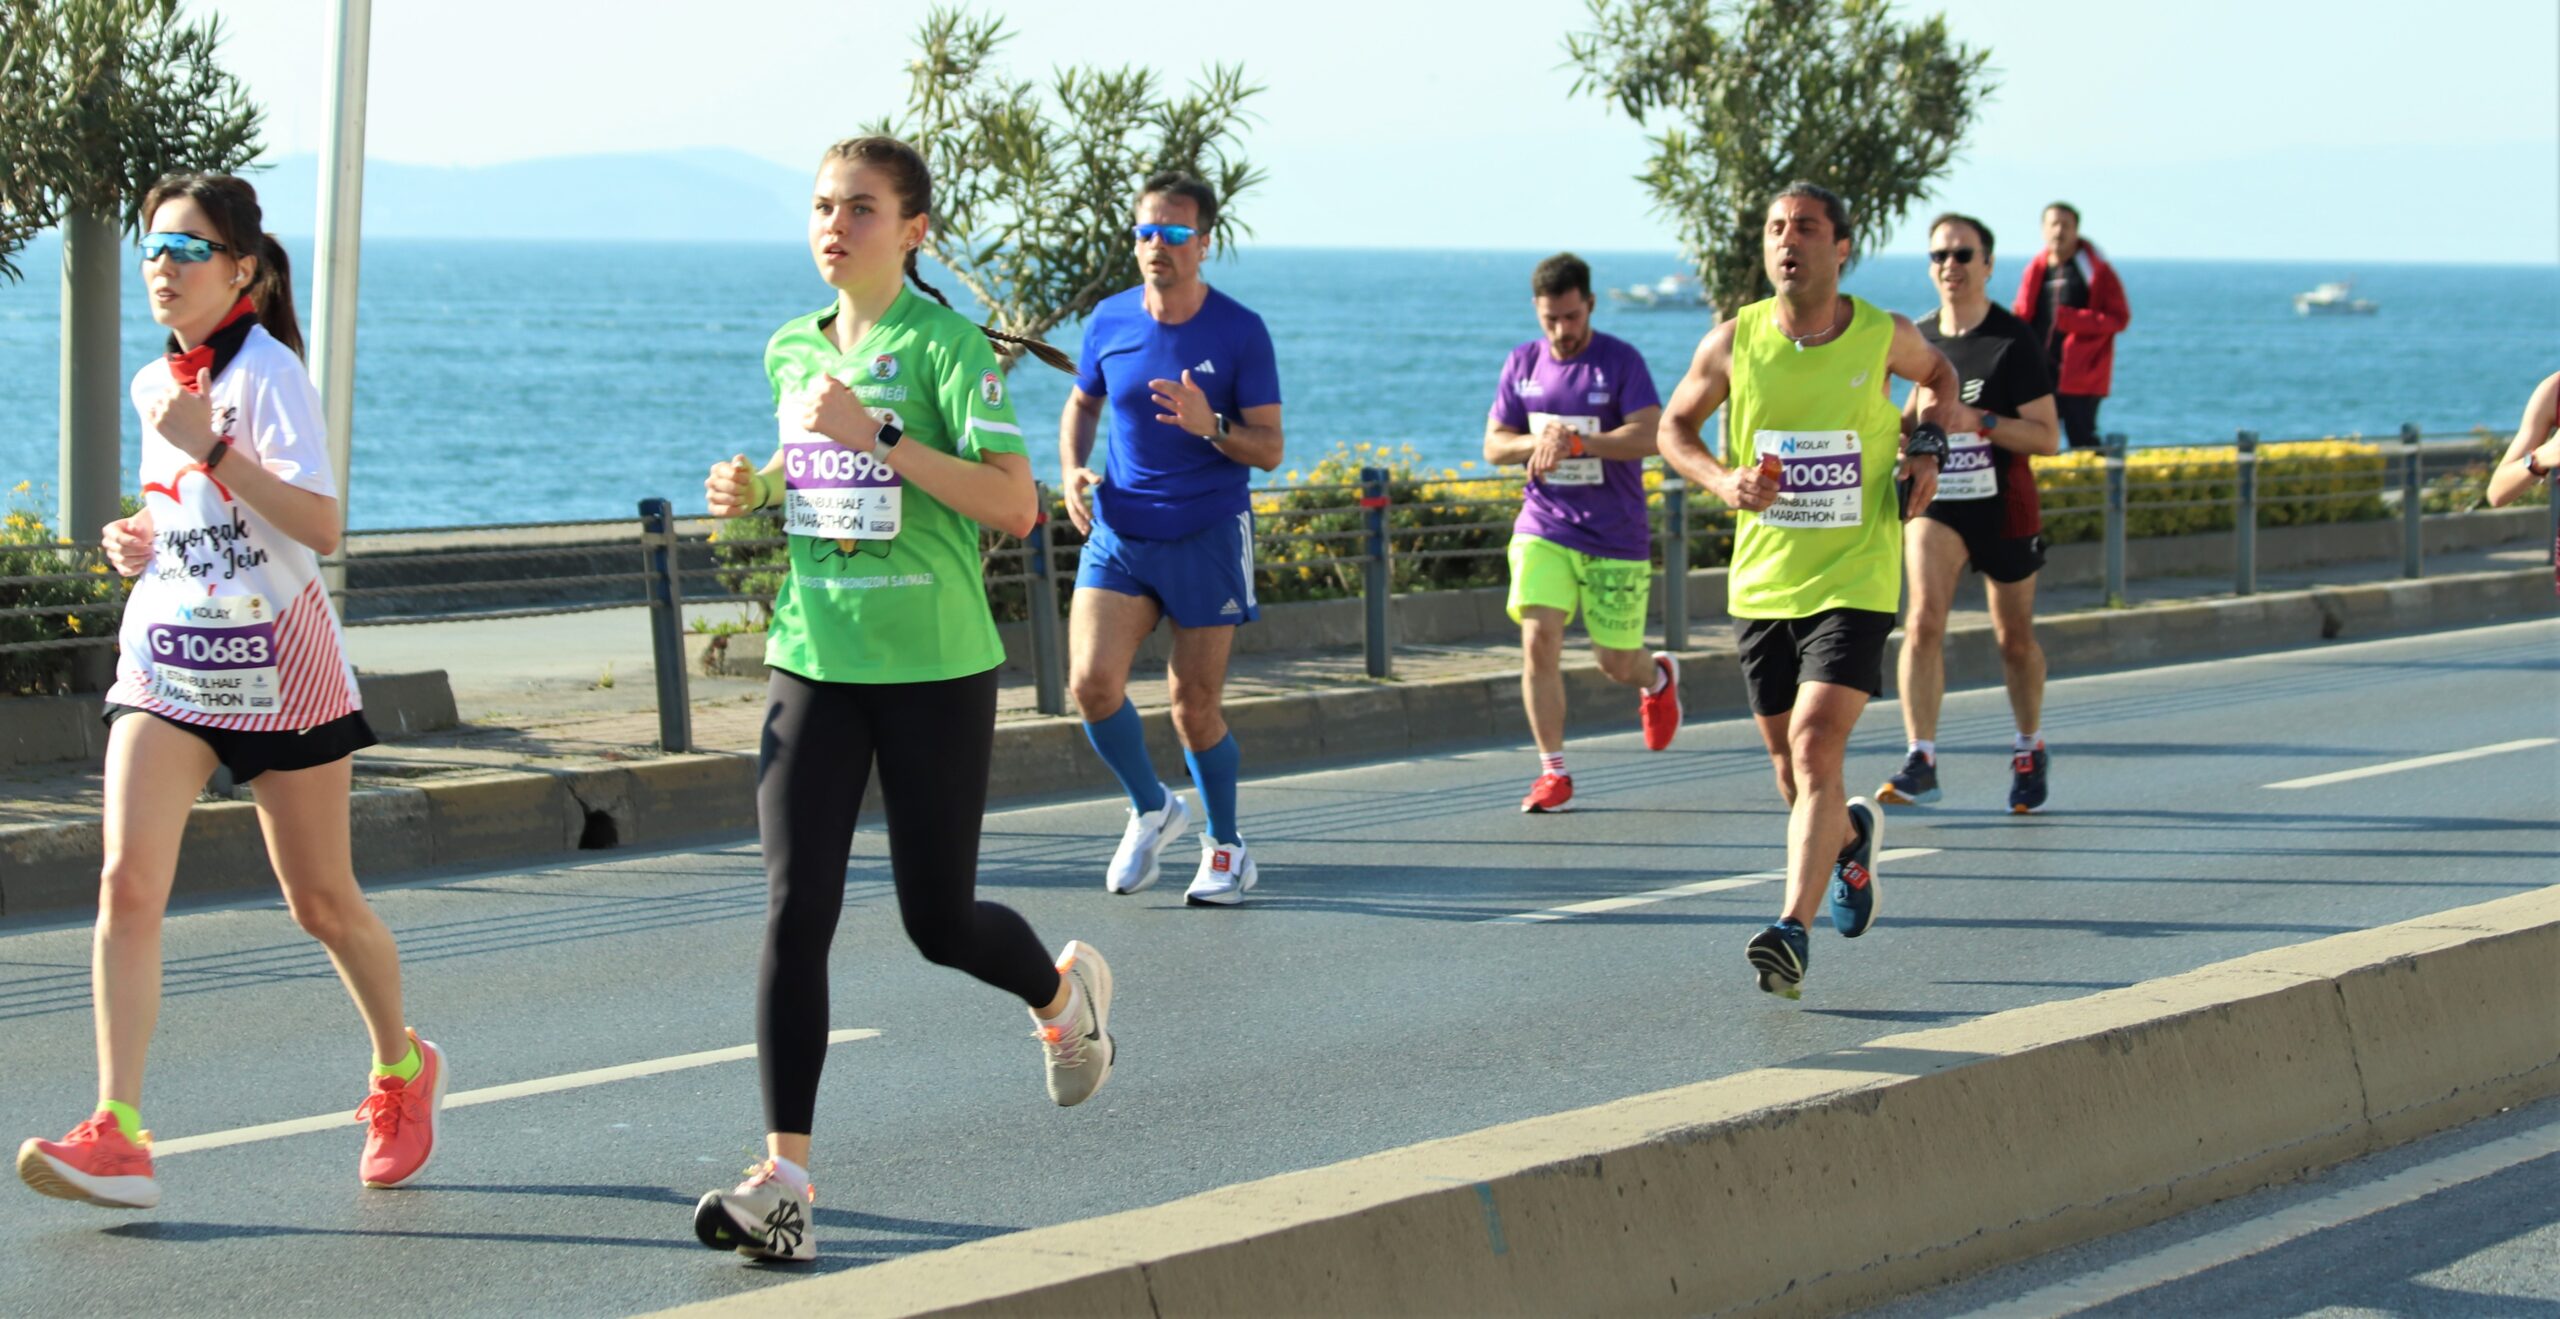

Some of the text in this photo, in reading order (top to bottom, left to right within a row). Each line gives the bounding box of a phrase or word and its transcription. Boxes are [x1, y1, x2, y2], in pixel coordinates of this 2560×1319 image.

[1796, 440, 1830, 450] KOLAY
[787, 448, 806, 478] G
[1783, 462, 1858, 487] 10036
[837, 497, 865, 510] HALF
[1810, 497, 1835, 507] HALF
[1769, 511, 1835, 522] MARATHON
[193, 607, 231, 620] KOLAY
[151, 628, 269, 664] G 10683
[166, 669, 211, 689] ISTANBUL
[212, 678, 243, 689] HALF
[164, 685, 244, 707] MARATHON
